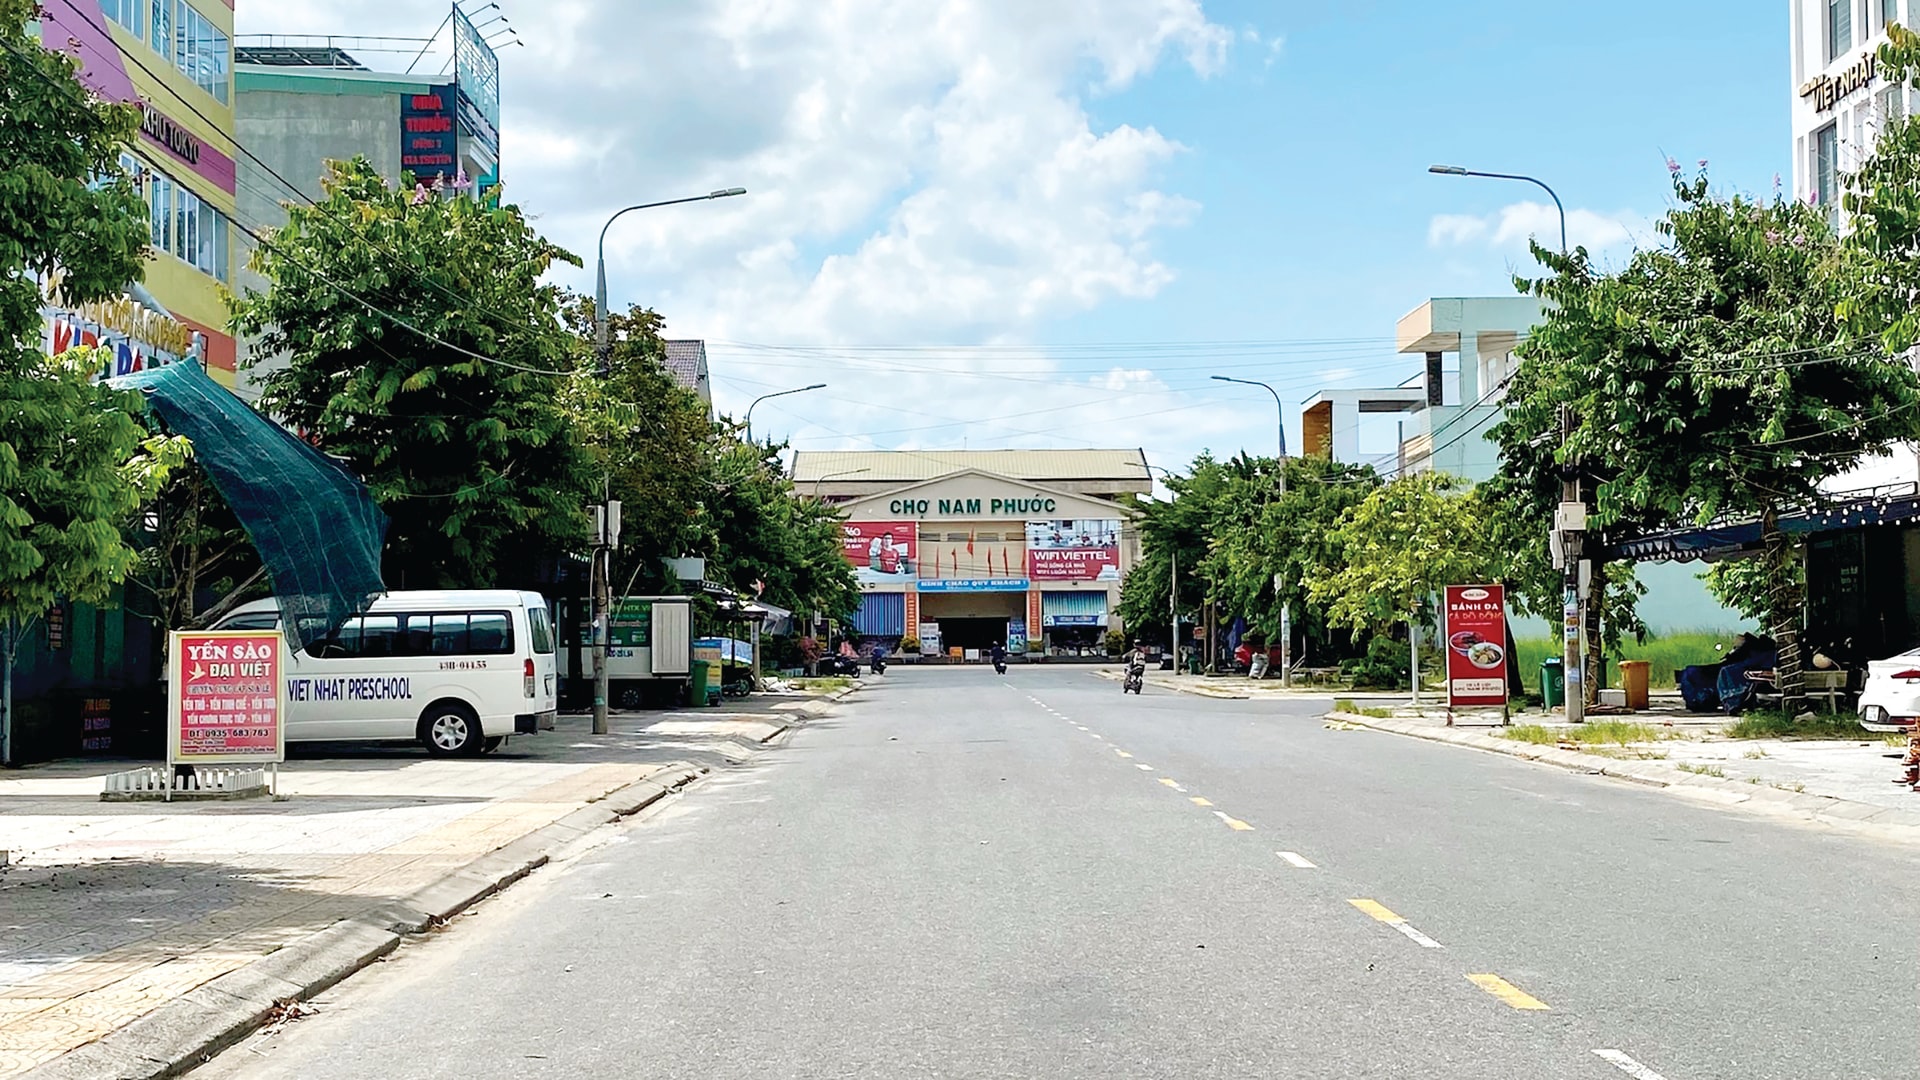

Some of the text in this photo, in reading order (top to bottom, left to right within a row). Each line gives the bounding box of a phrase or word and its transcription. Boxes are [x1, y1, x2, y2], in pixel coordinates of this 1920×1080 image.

[1812, 76, 1841, 113] VIỆT
[143, 104, 199, 162] KHU TOKYO
[890, 494, 1056, 519] CHỢ NAM PHƯỚC
[1033, 551, 1110, 560] WIFI VIETTEL
[1451, 602, 1481, 611] BÁNH
[187, 639, 272, 660] YẾN SÀO
[209, 660, 272, 680] ĐẠI VIỆT
[288, 677, 412, 702] VIET NHAT PRESCHOOL
[205, 729, 227, 737] 0935
[232, 729, 249, 737] 683
